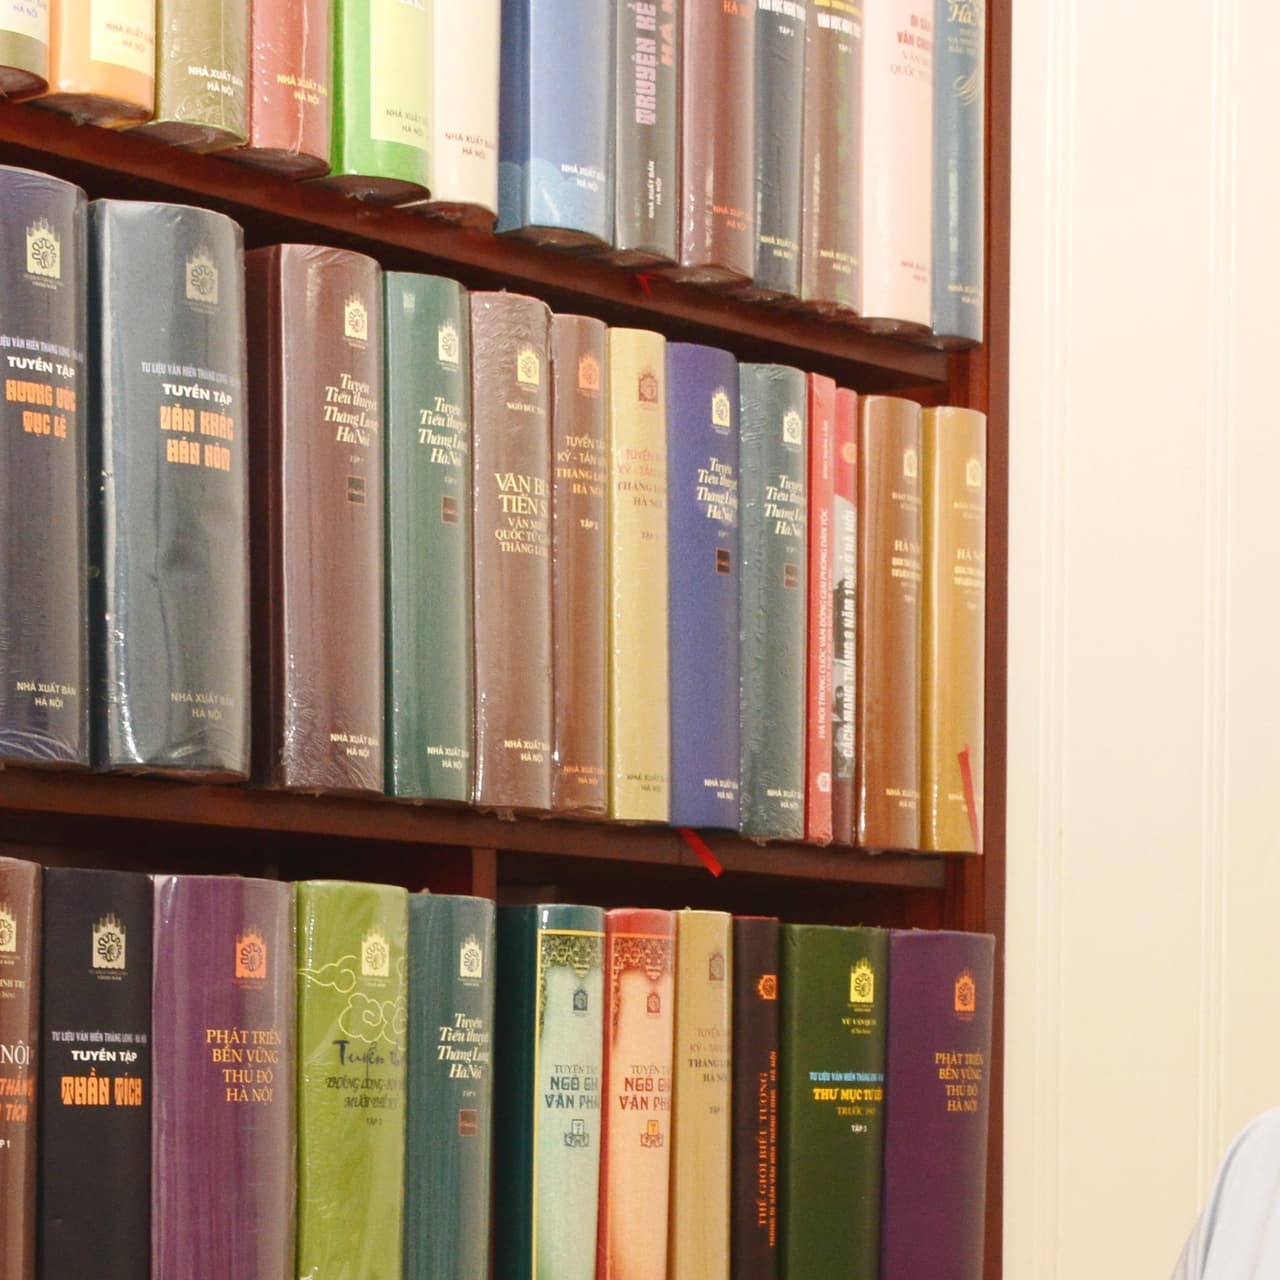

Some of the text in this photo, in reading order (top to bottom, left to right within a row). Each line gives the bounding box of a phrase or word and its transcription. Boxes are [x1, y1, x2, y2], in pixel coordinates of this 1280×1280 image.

[213, 390, 232, 406] TẬP
[206, 1028, 248, 1045] PHÁT
[226, 1087, 248, 1102] HÀ
